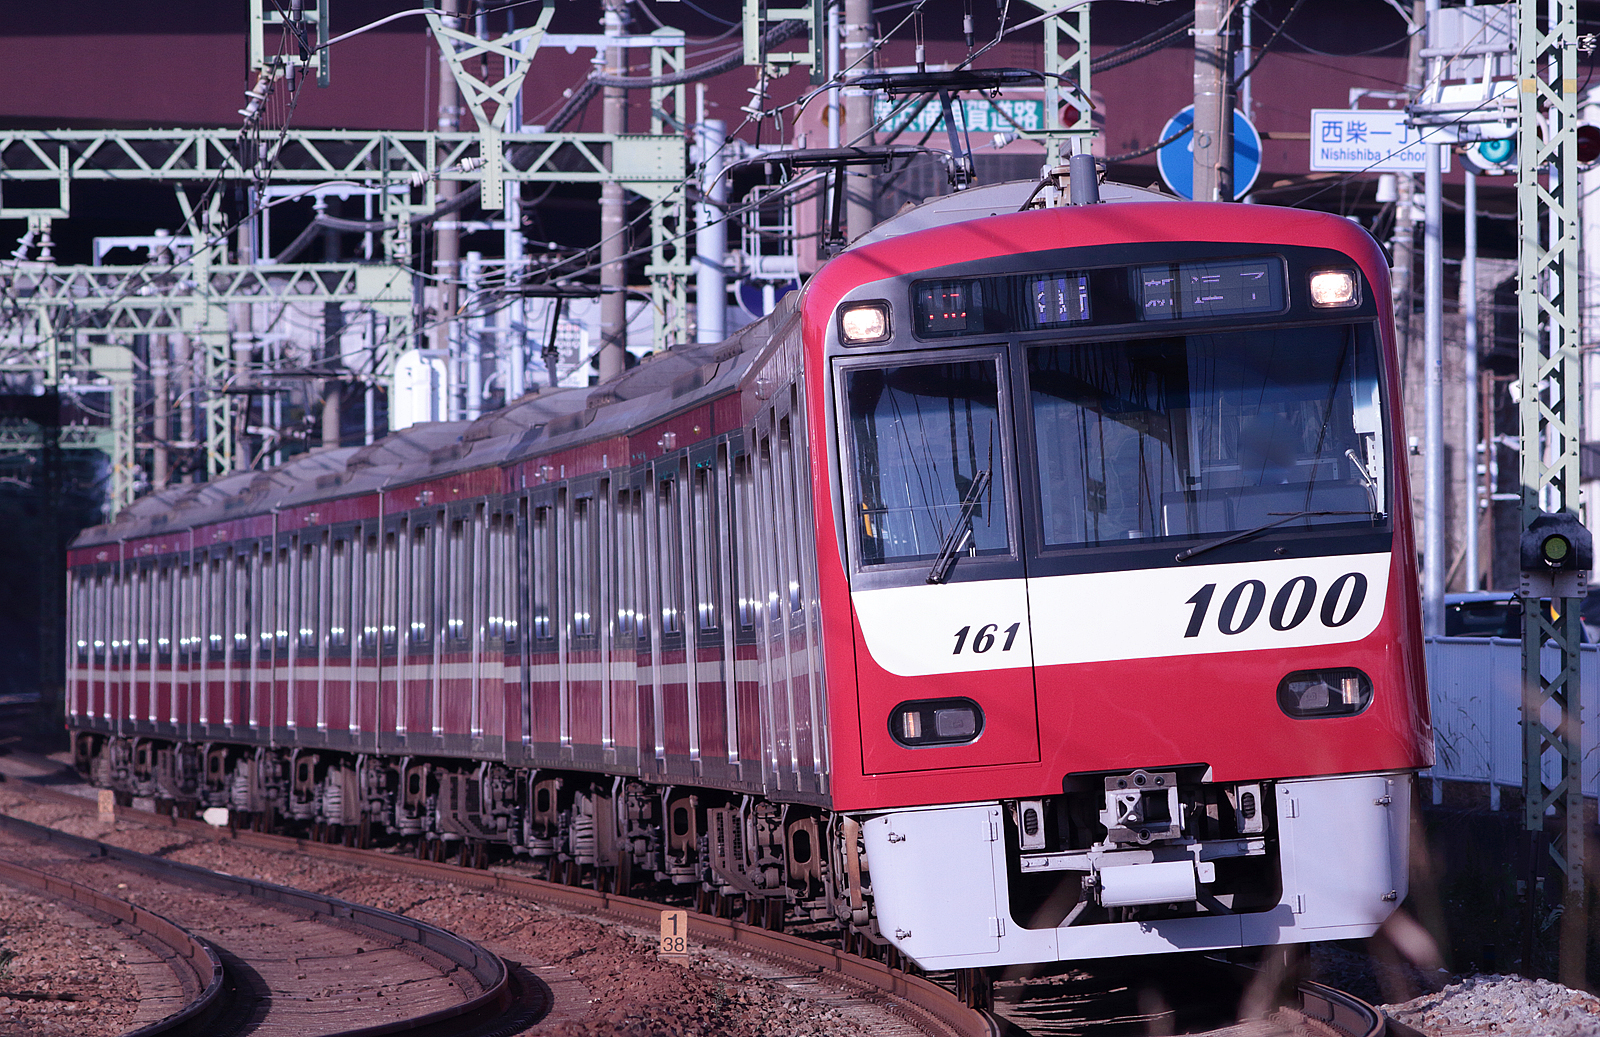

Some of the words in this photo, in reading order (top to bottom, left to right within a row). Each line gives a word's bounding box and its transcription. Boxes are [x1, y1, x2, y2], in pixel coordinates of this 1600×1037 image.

[1322, 120, 1426, 145] 西柴一丁
[1321, 148, 1381, 161] Nishishiba
[1184, 572, 1368, 638] 1000
[953, 622, 1020, 655] 161
[667, 913, 678, 936] 1
[663, 937, 684, 952] 38
